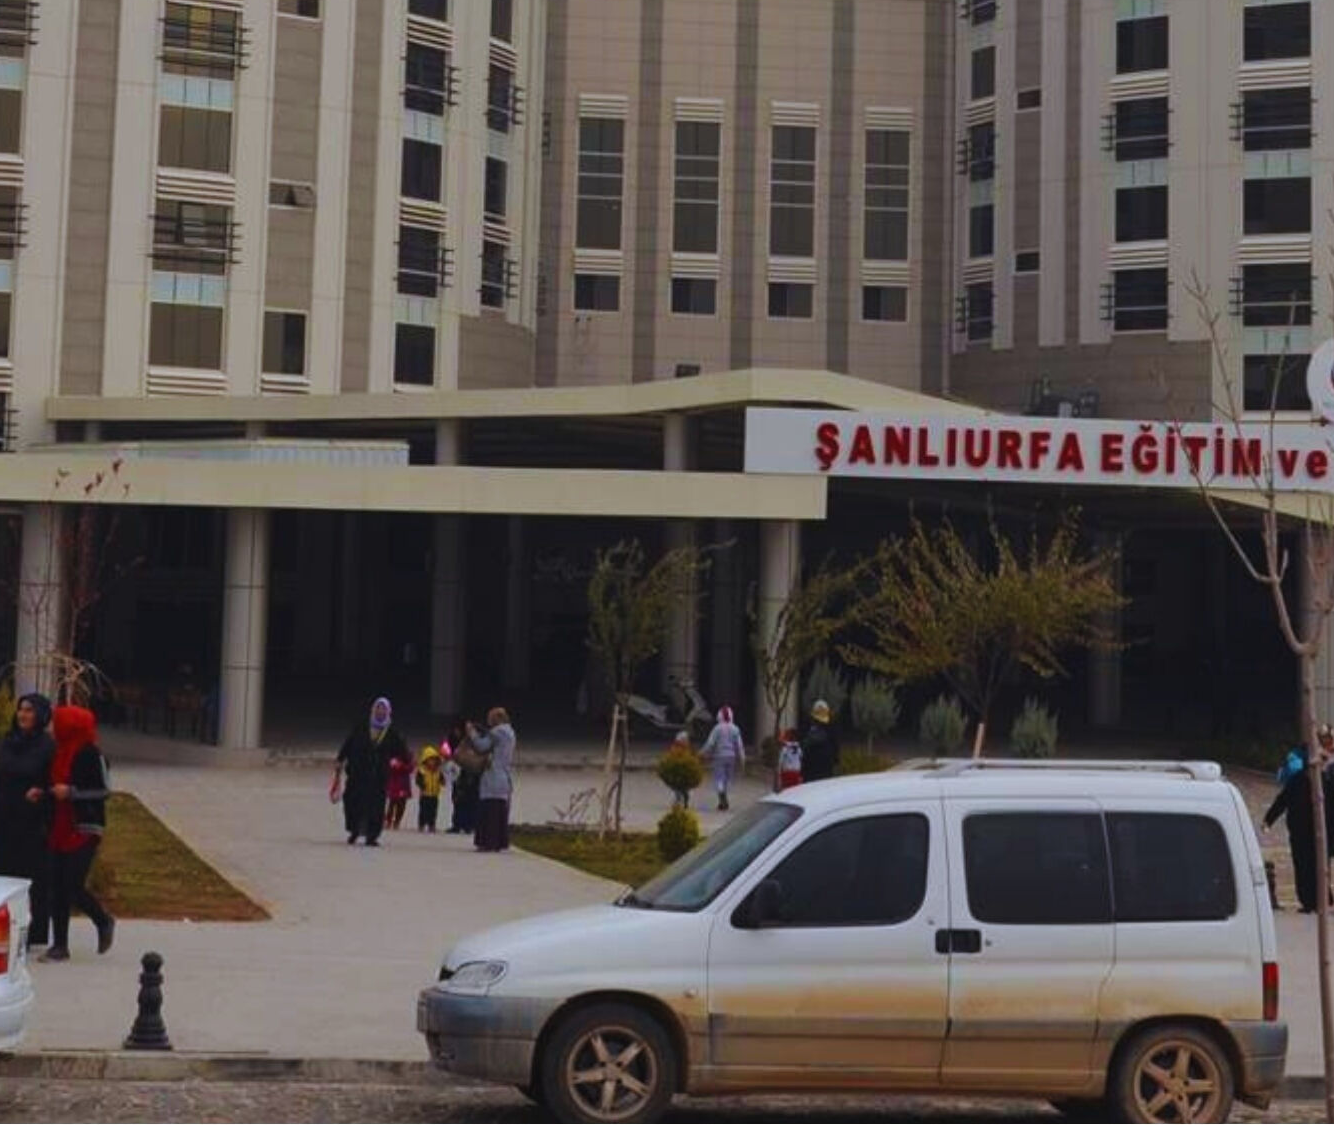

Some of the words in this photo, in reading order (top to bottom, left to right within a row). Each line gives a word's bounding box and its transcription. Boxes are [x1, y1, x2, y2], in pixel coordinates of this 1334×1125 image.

[815, 422, 1085, 472] ŞANLIURFA
[1099, 424, 1264, 479] EĞİTİM
[1277, 449, 1329, 479] ve
